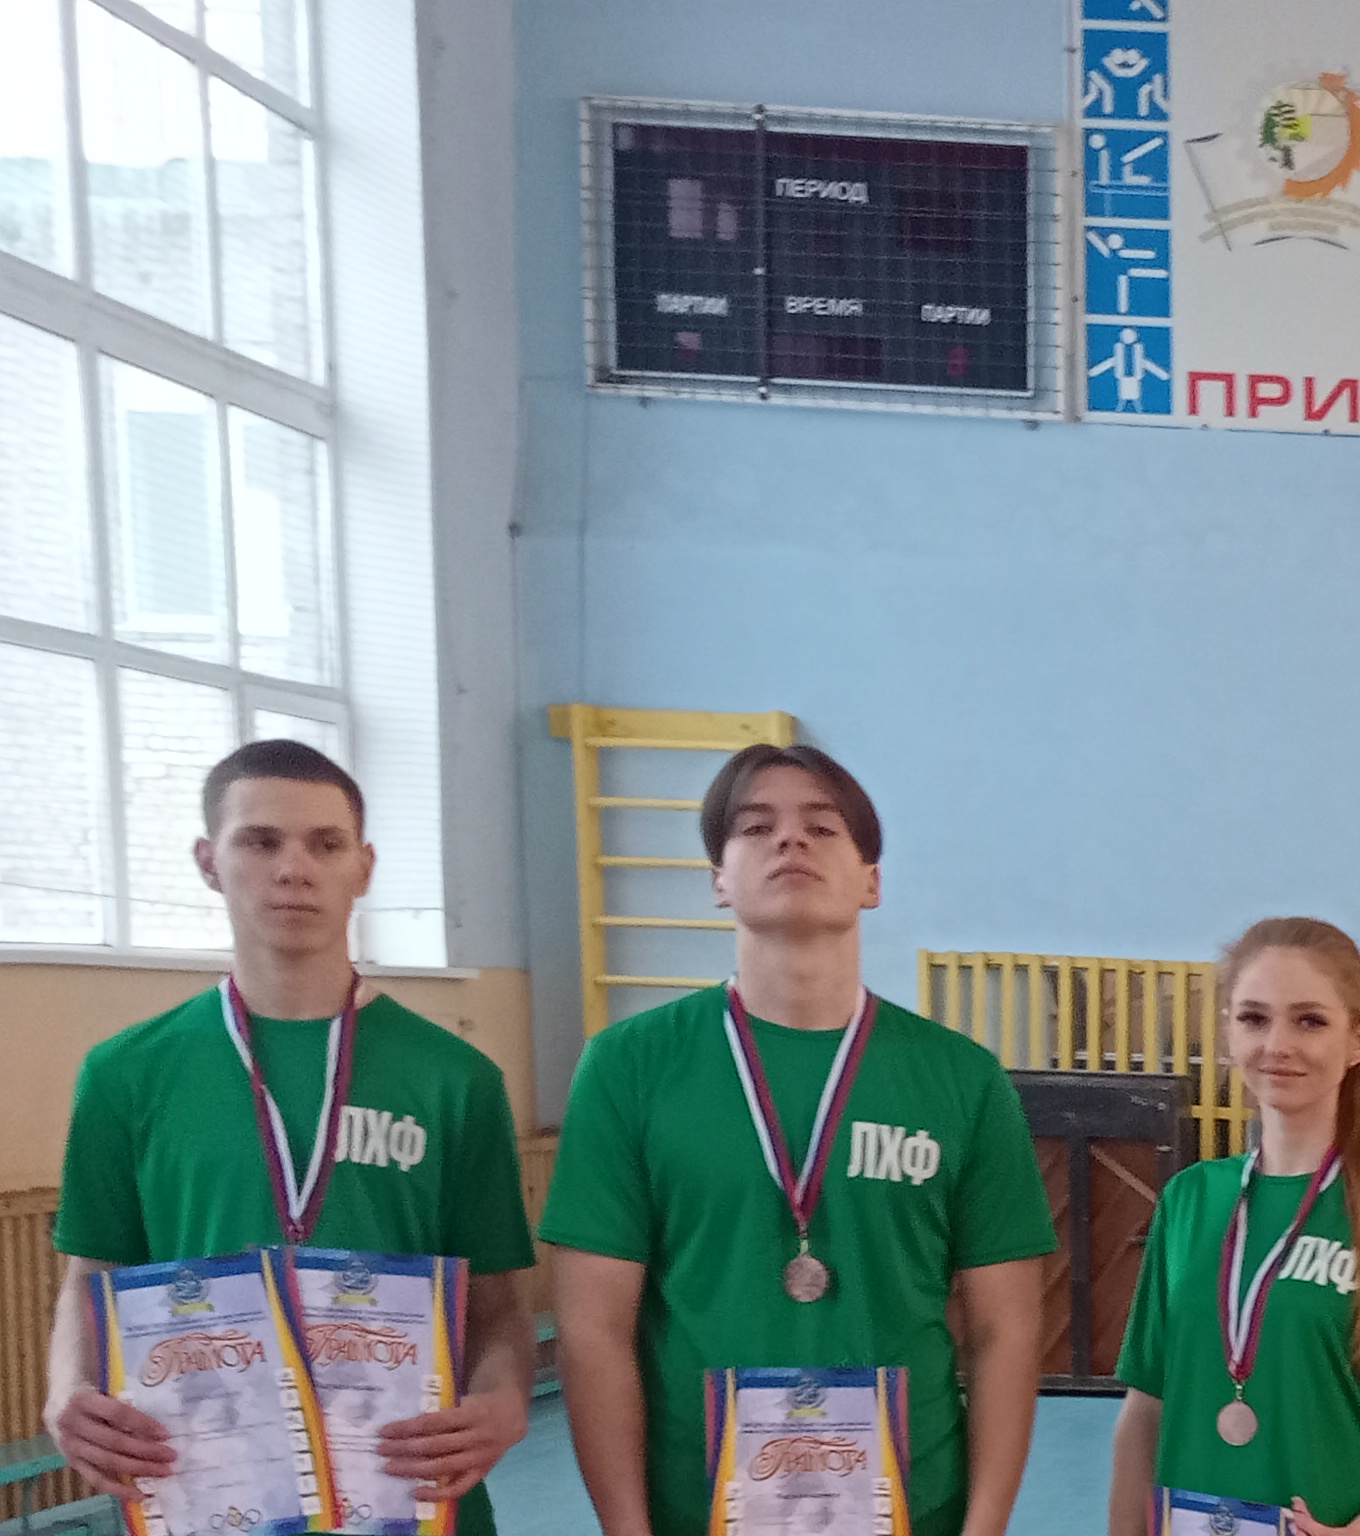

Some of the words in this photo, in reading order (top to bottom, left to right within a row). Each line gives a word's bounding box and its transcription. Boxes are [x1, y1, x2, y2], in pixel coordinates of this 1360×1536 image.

[775, 178, 869, 203] ПЕРИОД
[785, 296, 863, 317] ВРЕМЯ
[334, 1105, 428, 1172] ЛХФ
[847, 1121, 942, 1185] ЛХФ
